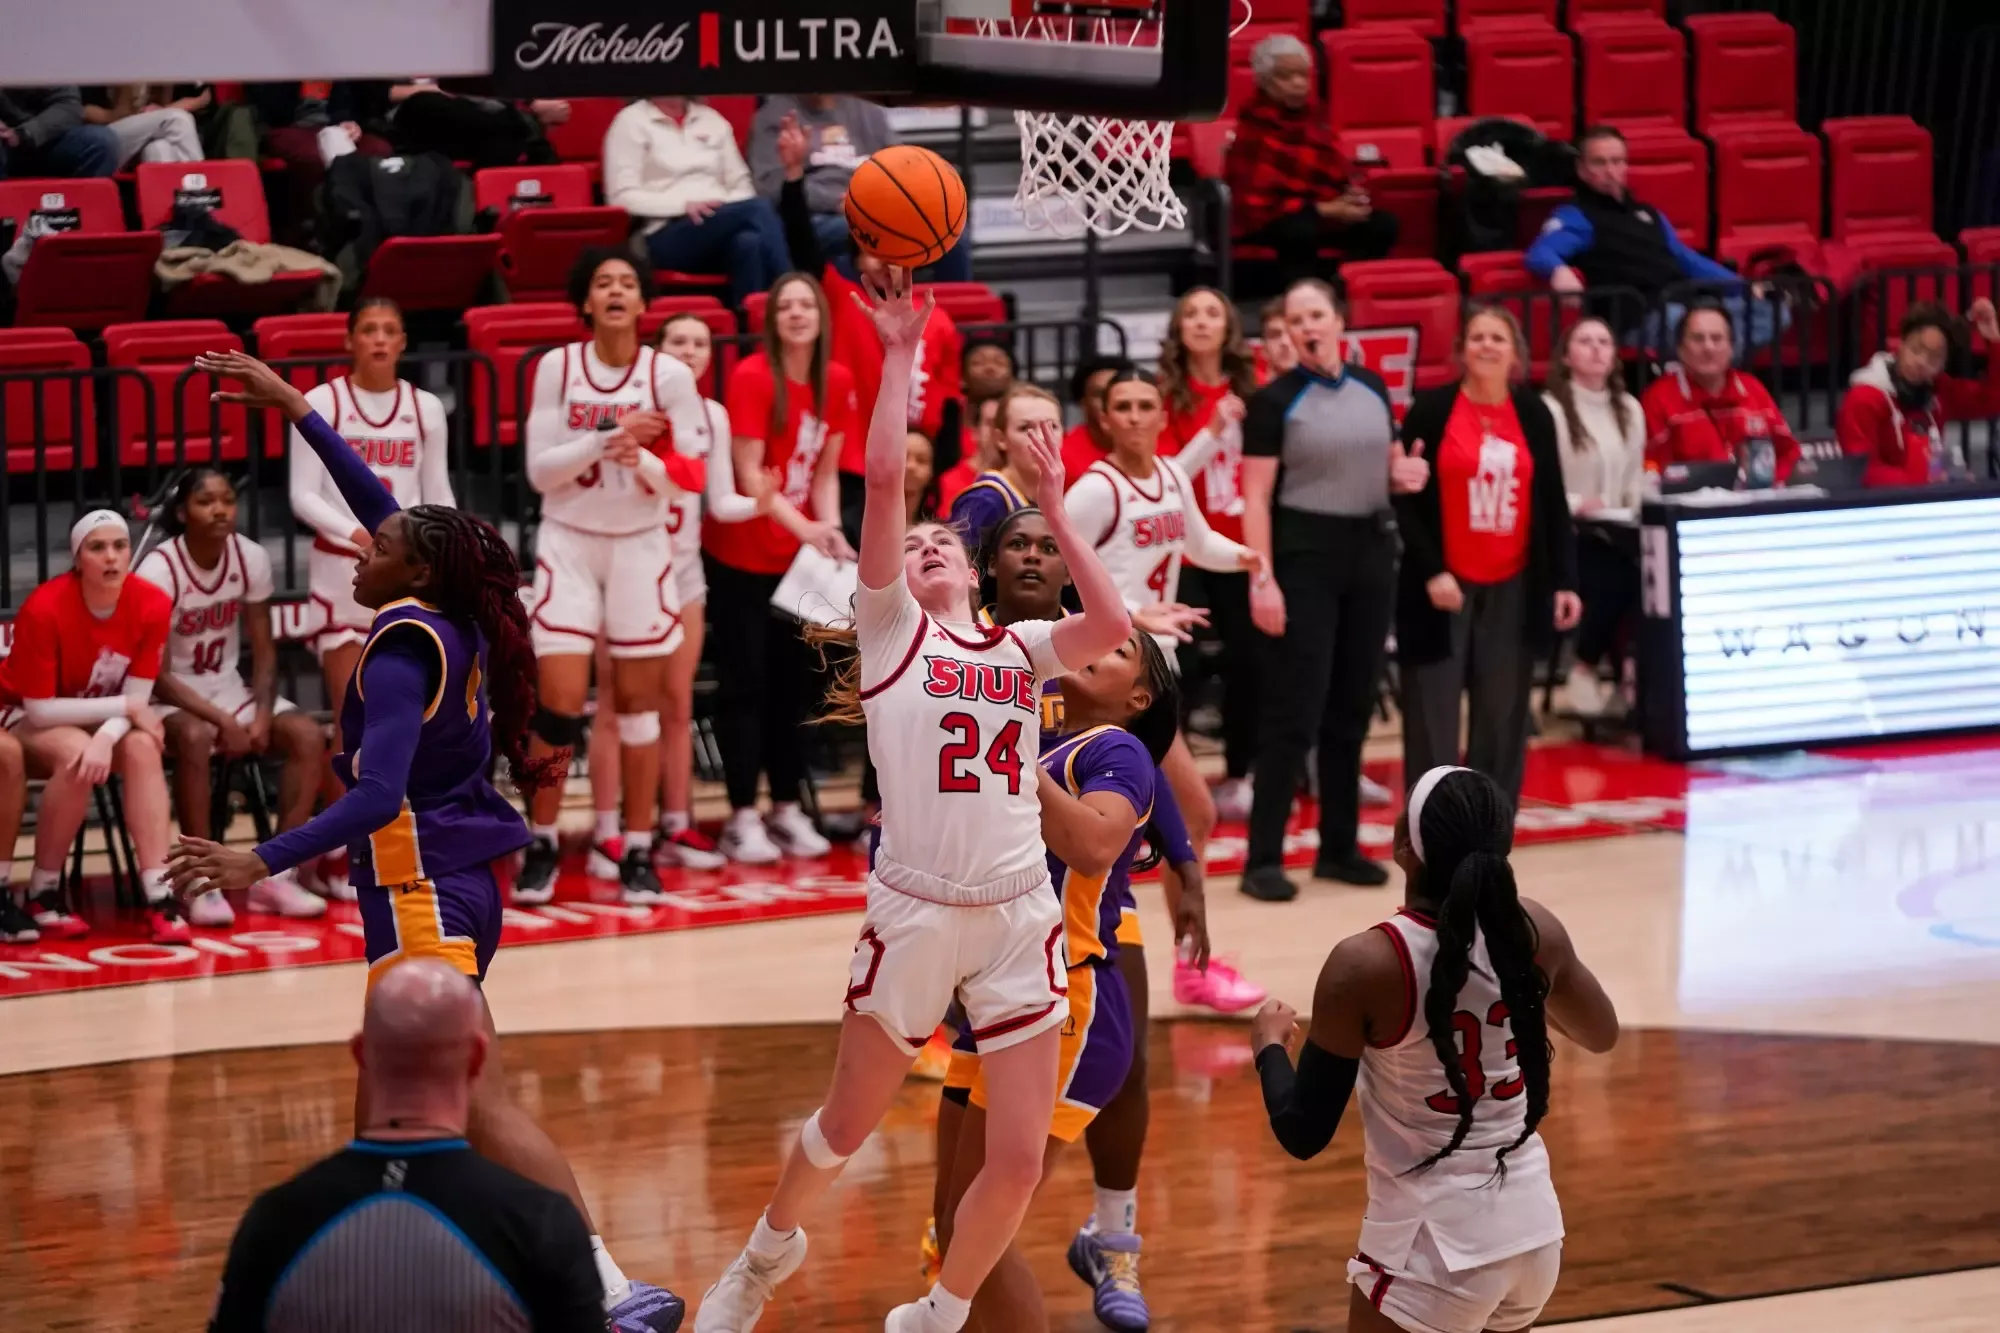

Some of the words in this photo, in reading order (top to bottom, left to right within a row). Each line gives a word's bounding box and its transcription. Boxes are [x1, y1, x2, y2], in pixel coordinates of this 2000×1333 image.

[515, 21, 690, 70] Michelob
[734, 17, 900, 63] ULTRA
[1147, 553, 1173, 602] 4
[192, 637, 226, 675] 10
[923, 655, 1036, 714] SIUE
[939, 711, 1024, 796] 24
